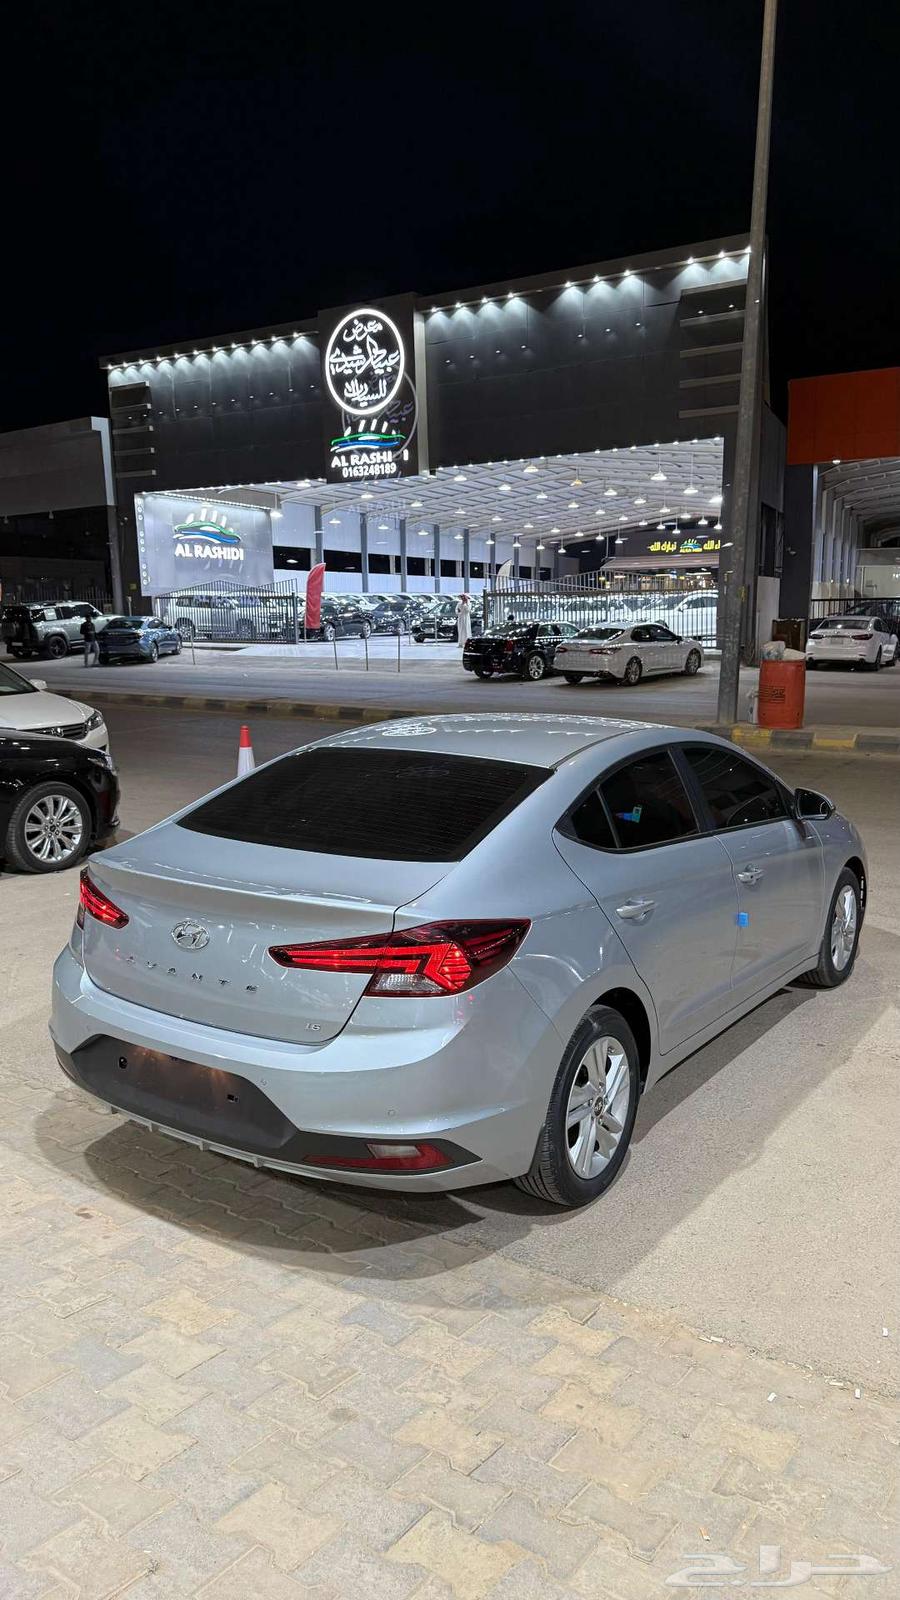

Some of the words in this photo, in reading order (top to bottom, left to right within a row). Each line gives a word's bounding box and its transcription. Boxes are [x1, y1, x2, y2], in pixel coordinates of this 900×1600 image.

[343, 318, 383, 342] معرض
[343, 377, 387, 408] للسيارات
[331, 455, 349, 468] AL
[350, 449, 409, 466] RASHII
[342, 462, 397, 478] 0163248189
[174, 543, 193, 557] AL
[193, 544, 244, 561] RASHIDI
